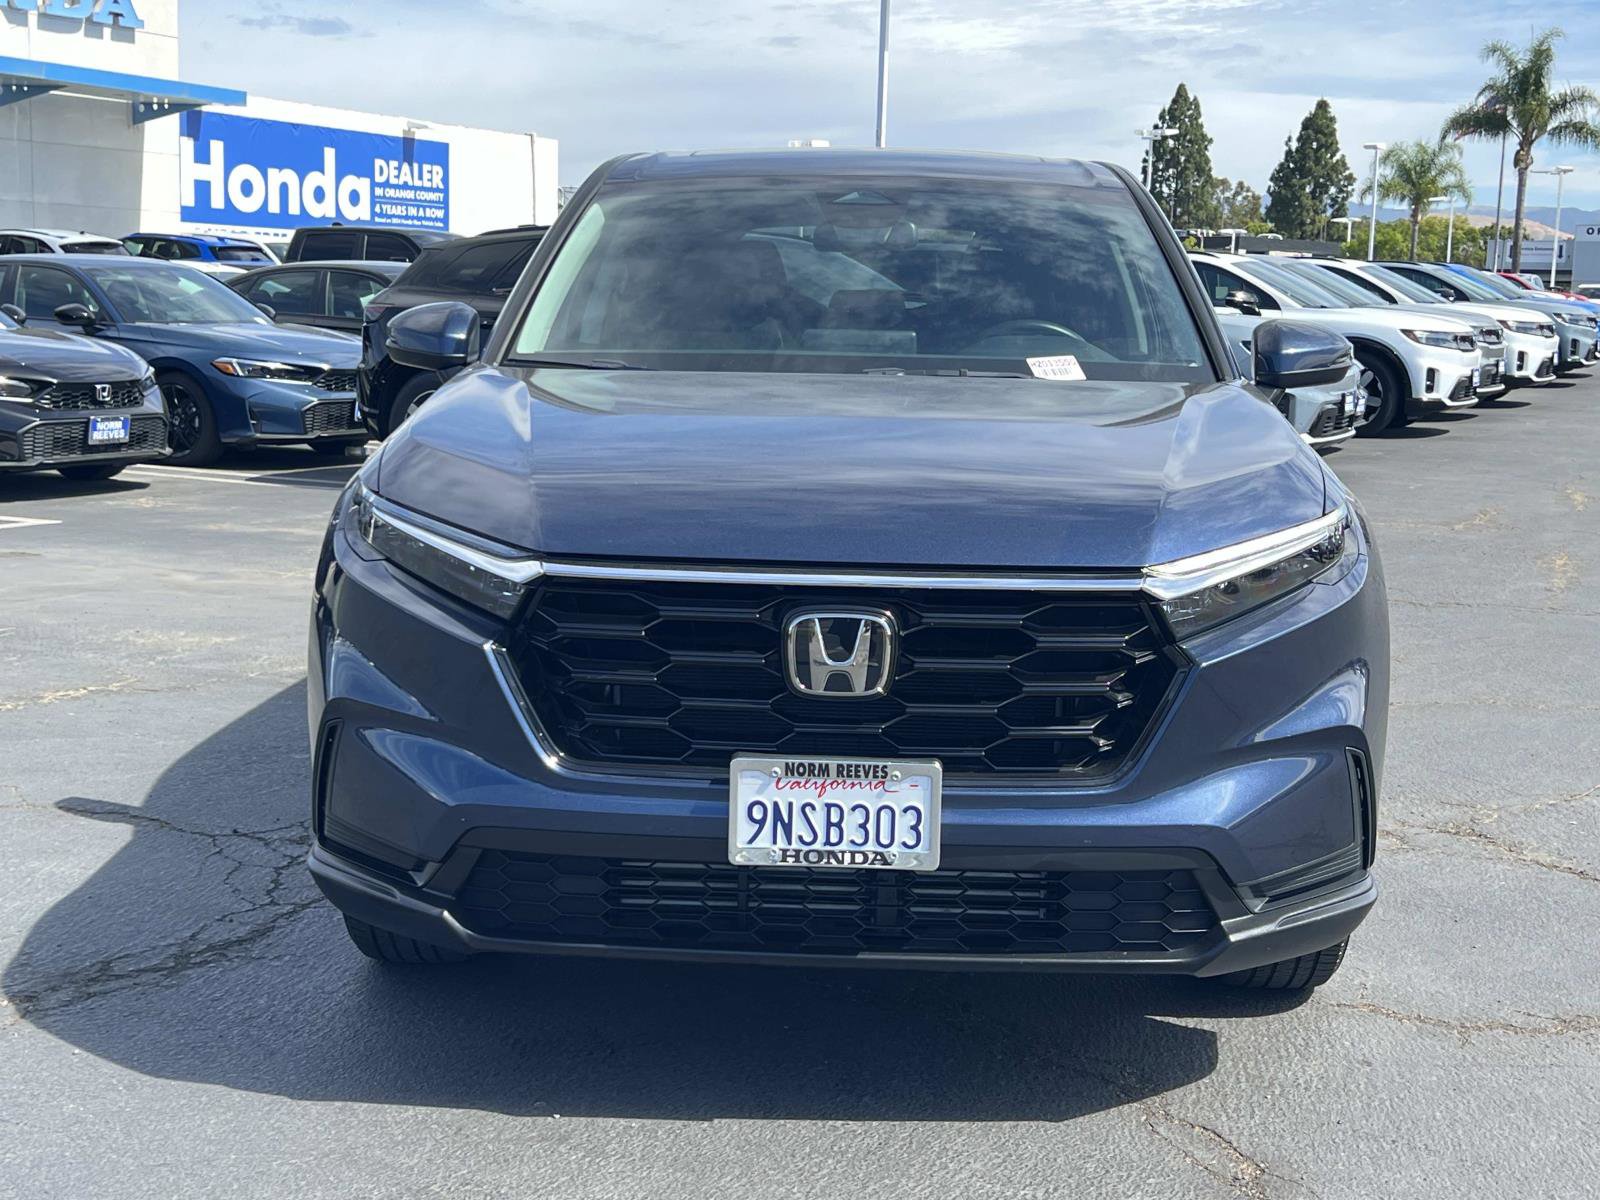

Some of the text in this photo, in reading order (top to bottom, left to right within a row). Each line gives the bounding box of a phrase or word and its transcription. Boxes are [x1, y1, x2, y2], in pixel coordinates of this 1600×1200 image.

[180, 136, 371, 221] Honda
[374, 158, 444, 189] DEALER
[374, 187, 444, 202] IN ORANGE COUNTY
[374, 203, 445, 219] 4 YEARS IN A ROW
[93, 429, 124, 440] REEVES
[96, 421, 122, 430] NORM
[784, 762, 889, 780] NORM REEVES
[775, 778, 900, 798] California
[746, 799, 923, 850] 9NSB303
[779, 848, 893, 866] HONDA
